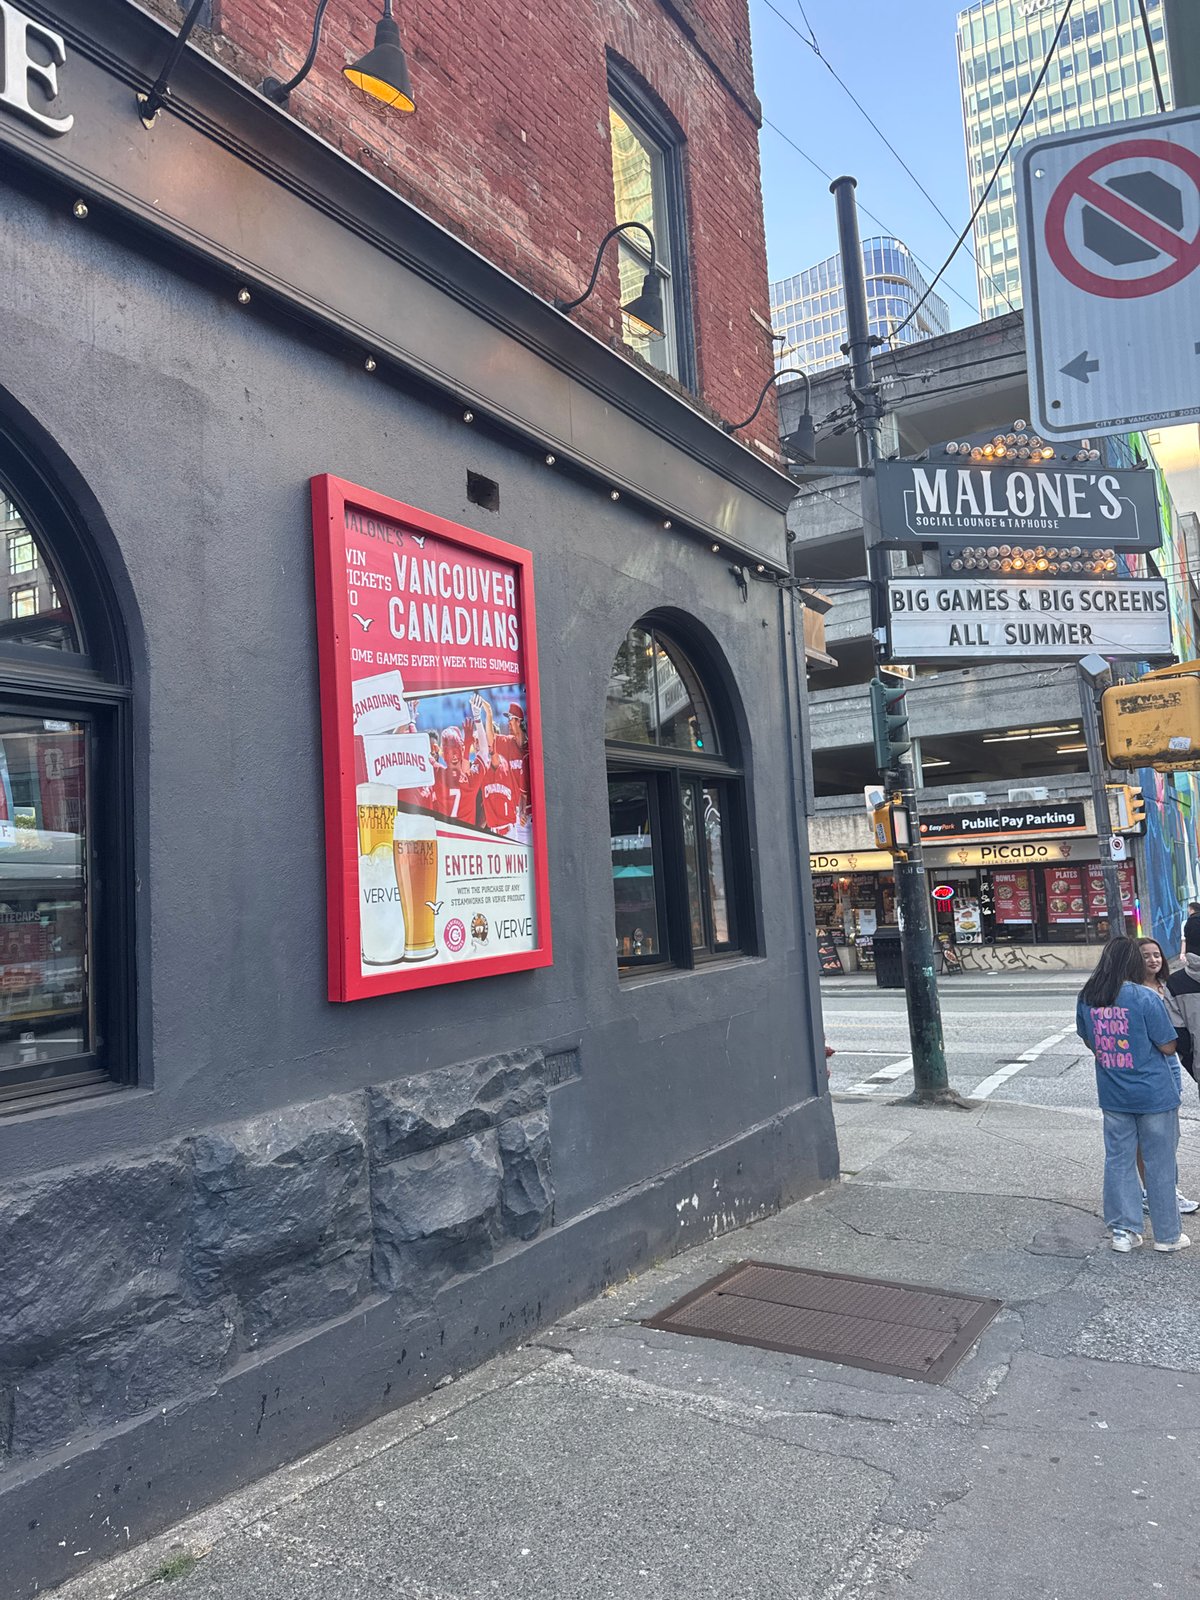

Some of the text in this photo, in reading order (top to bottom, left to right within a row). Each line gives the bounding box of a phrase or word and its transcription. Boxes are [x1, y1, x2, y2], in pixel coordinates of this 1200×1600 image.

[1128, 411, 1176, 424] VANCOUVER
[1179, 408, 1199, 416] 2020
[911, 467, 1123, 520] MALONE'S
[916, 516, 1060, 529] SOCIAL LOUNGE & TAPHOUSE
[347, 568, 392, 591] ICKETS
[393, 551, 516, 609] VANCOUVER
[347, 590, 358, 606] O
[890, 589, 1167, 612] BIG GAMES & BIG SCREENS
[388, 596, 519, 652] CANADIANS
[950, 623, 1094, 646] ALL SUMMER
[350, 647, 519, 674] OME GAMES EVERY WEEK THIS SUMMER
[374, 752, 426, 777] CANADIANS
[449, 788, 461, 818] 7
[359, 806, 396, 819] STEAM
[928, 823, 955, 832] EasyPark
[961, 816, 1000, 830] Public
[1001, 815, 1024, 832] Pay
[1026, 811, 1075, 829] Parking
[397, 842, 434, 855] STEAM
[980, 844, 1048, 859] PiCaDo
[445, 854, 528, 876] ENTER TO WIN!
[995, 874, 1016, 882] BOWLS
[1055, 870, 1078, 879] PLATES
[364, 887, 401, 903] VERVE
[456, 887, 471, 895] WITH
[471, 886, 480, 894] THE
[481, 885, 504, 893] PURCHASE
[511, 884, 520, 892] ANY
[451, 896, 484, 906] STEAMWORKS
[492, 895, 506, 903] VERVE
[507, 894, 526, 902] PRODUCT
[494, 917, 533, 940] VERVE
[1090, 1006, 1130, 1020] MORE
[1094, 1034, 1117, 1051] POR
[1094, 1049, 1134, 1069] FAVOR
